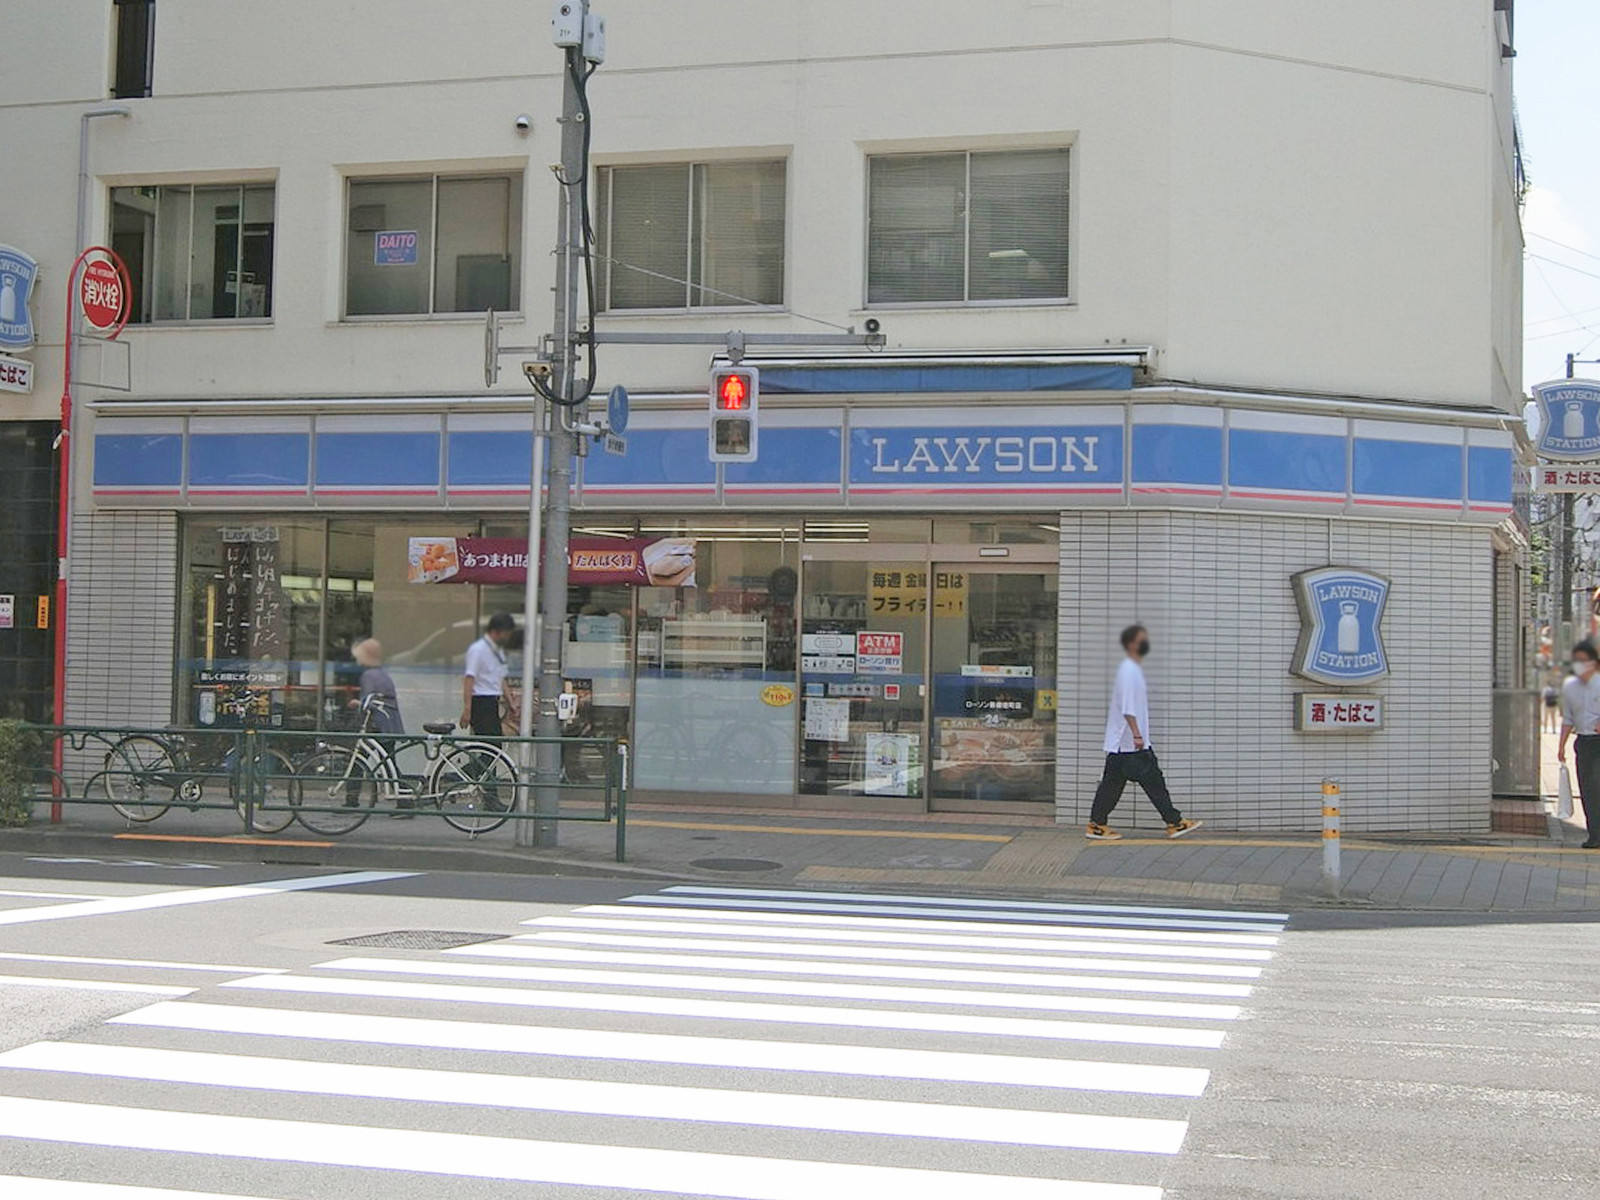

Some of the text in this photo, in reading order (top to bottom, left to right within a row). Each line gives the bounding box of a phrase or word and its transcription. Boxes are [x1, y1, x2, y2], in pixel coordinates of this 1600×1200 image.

[379, 234, 415, 248] DAITO
[84, 278, 119, 310] 消火栓
[1547, 390, 1600, 402] LAWSON
[1546, 436, 1600, 449] STATION
[872, 437, 1098, 472] LAWSON
[1319, 586, 1378, 603] LAWSON
[864, 635, 896, 648] ATM
[1318, 652, 1378, 668] STATION
[1312, 703, 1375, 722] 酒・たばこ
